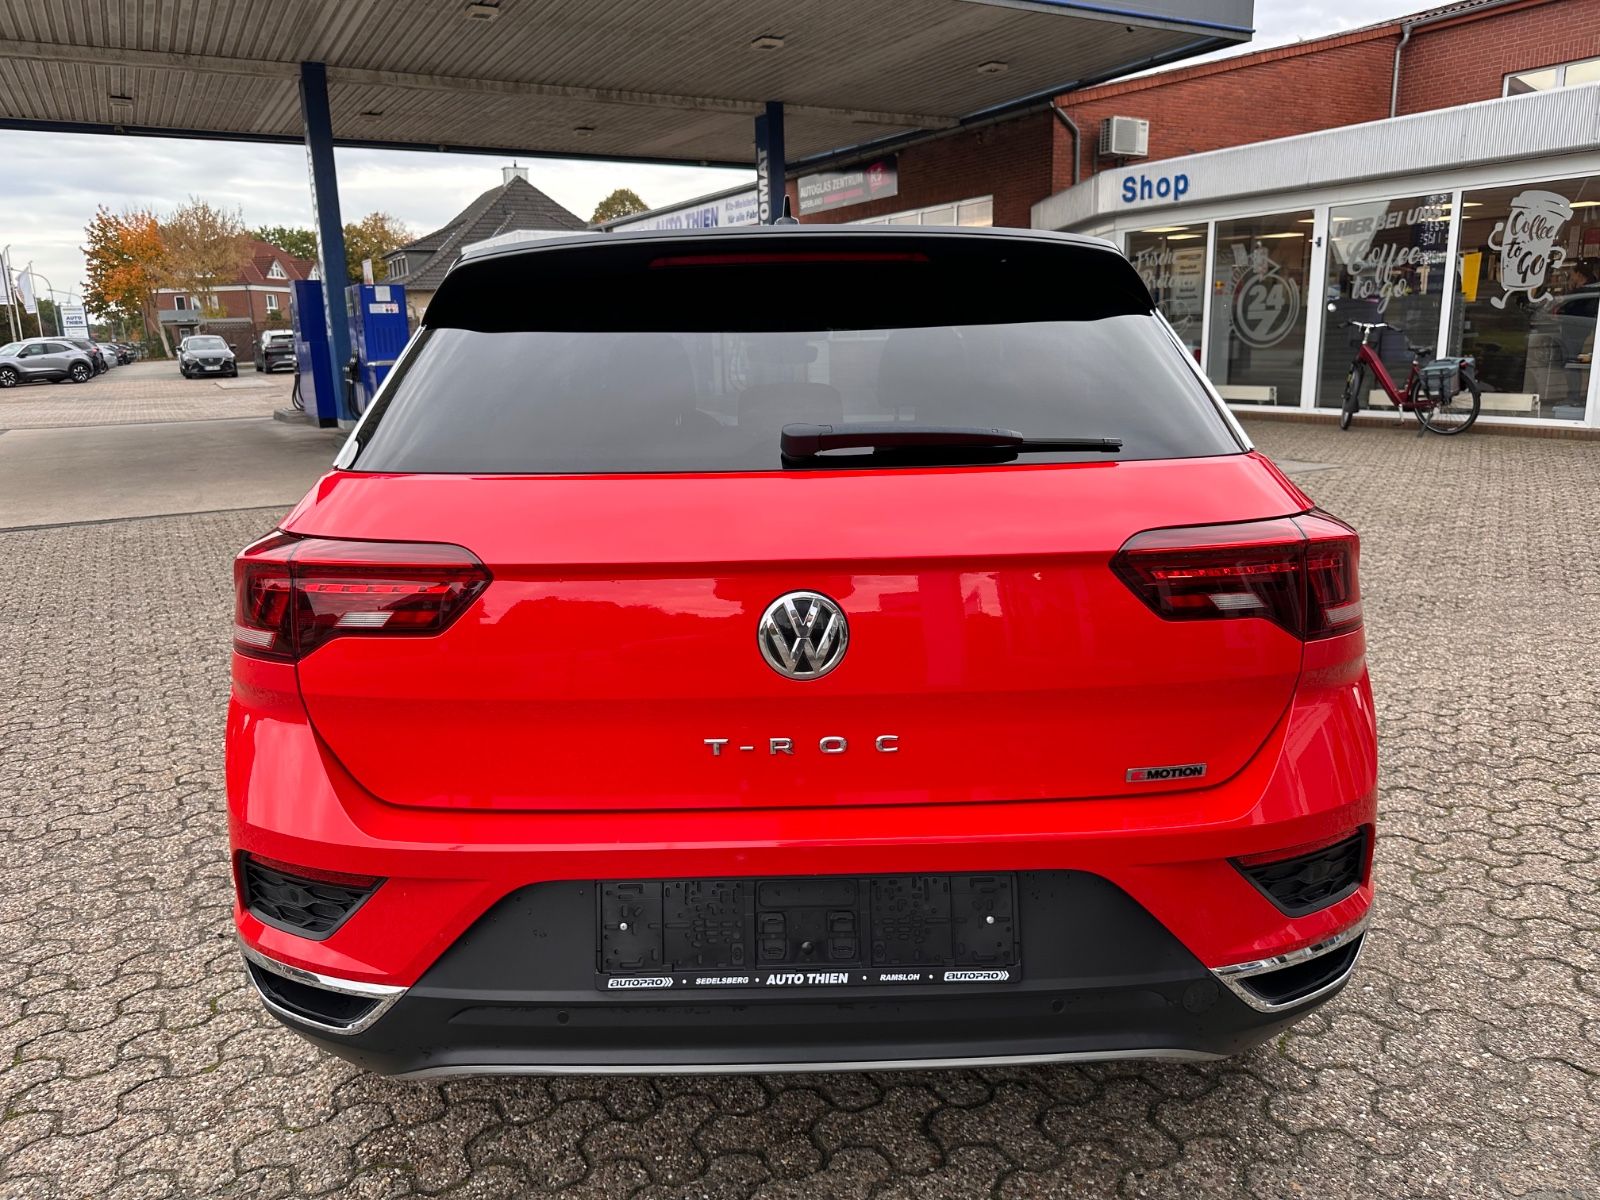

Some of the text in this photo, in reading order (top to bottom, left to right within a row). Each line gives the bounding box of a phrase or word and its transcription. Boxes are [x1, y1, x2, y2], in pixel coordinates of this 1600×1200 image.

[800, 181, 832, 198] AUTOGLAS
[832, 172, 864, 191] ZENTRUM
[1122, 174, 1188, 203] Shop
[685, 206, 719, 228] THIEN
[1336, 204, 1442, 237] HIER BEI UNS
[1511, 210, 1556, 241] Coffee
[1504, 237, 1522, 259] to
[1346, 242, 1420, 285] Coffee
[1247, 284, 1286, 311] 24
[1350, 276, 1407, 314] to go
[695, 976, 749, 985] SEDELSBERG
[766, 973, 804, 985] AUTO
[806, 972, 849, 984] THIEN
[880, 973, 920, 981] RAMSLOH
